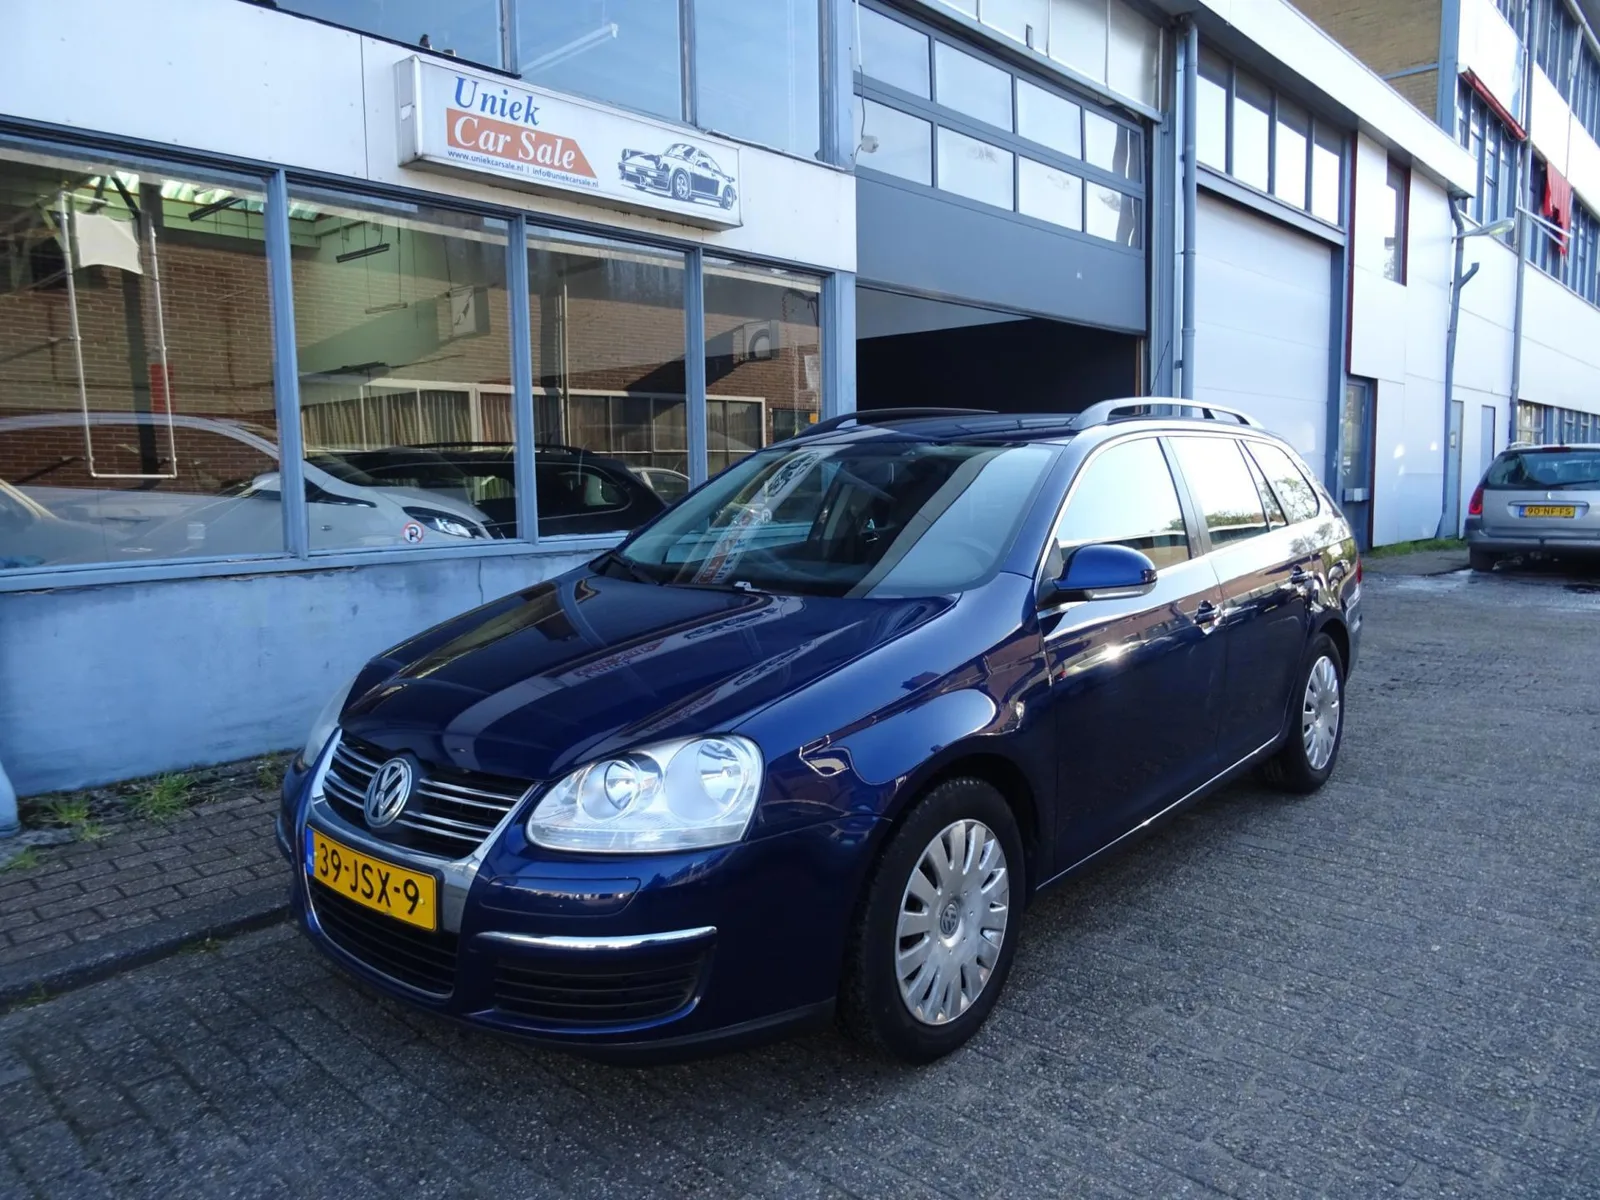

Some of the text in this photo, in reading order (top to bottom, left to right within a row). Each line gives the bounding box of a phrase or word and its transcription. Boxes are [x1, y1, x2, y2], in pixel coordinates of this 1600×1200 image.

[455, 76, 540, 126] Uniek
[447, 150, 524, 172] www.uniekcarsale.nl
[532, 168, 599, 188] info@uniekcarsale.nl
[454, 116, 576, 170] Car Sale
[319, 842, 420, 915] 39-JSX-9
